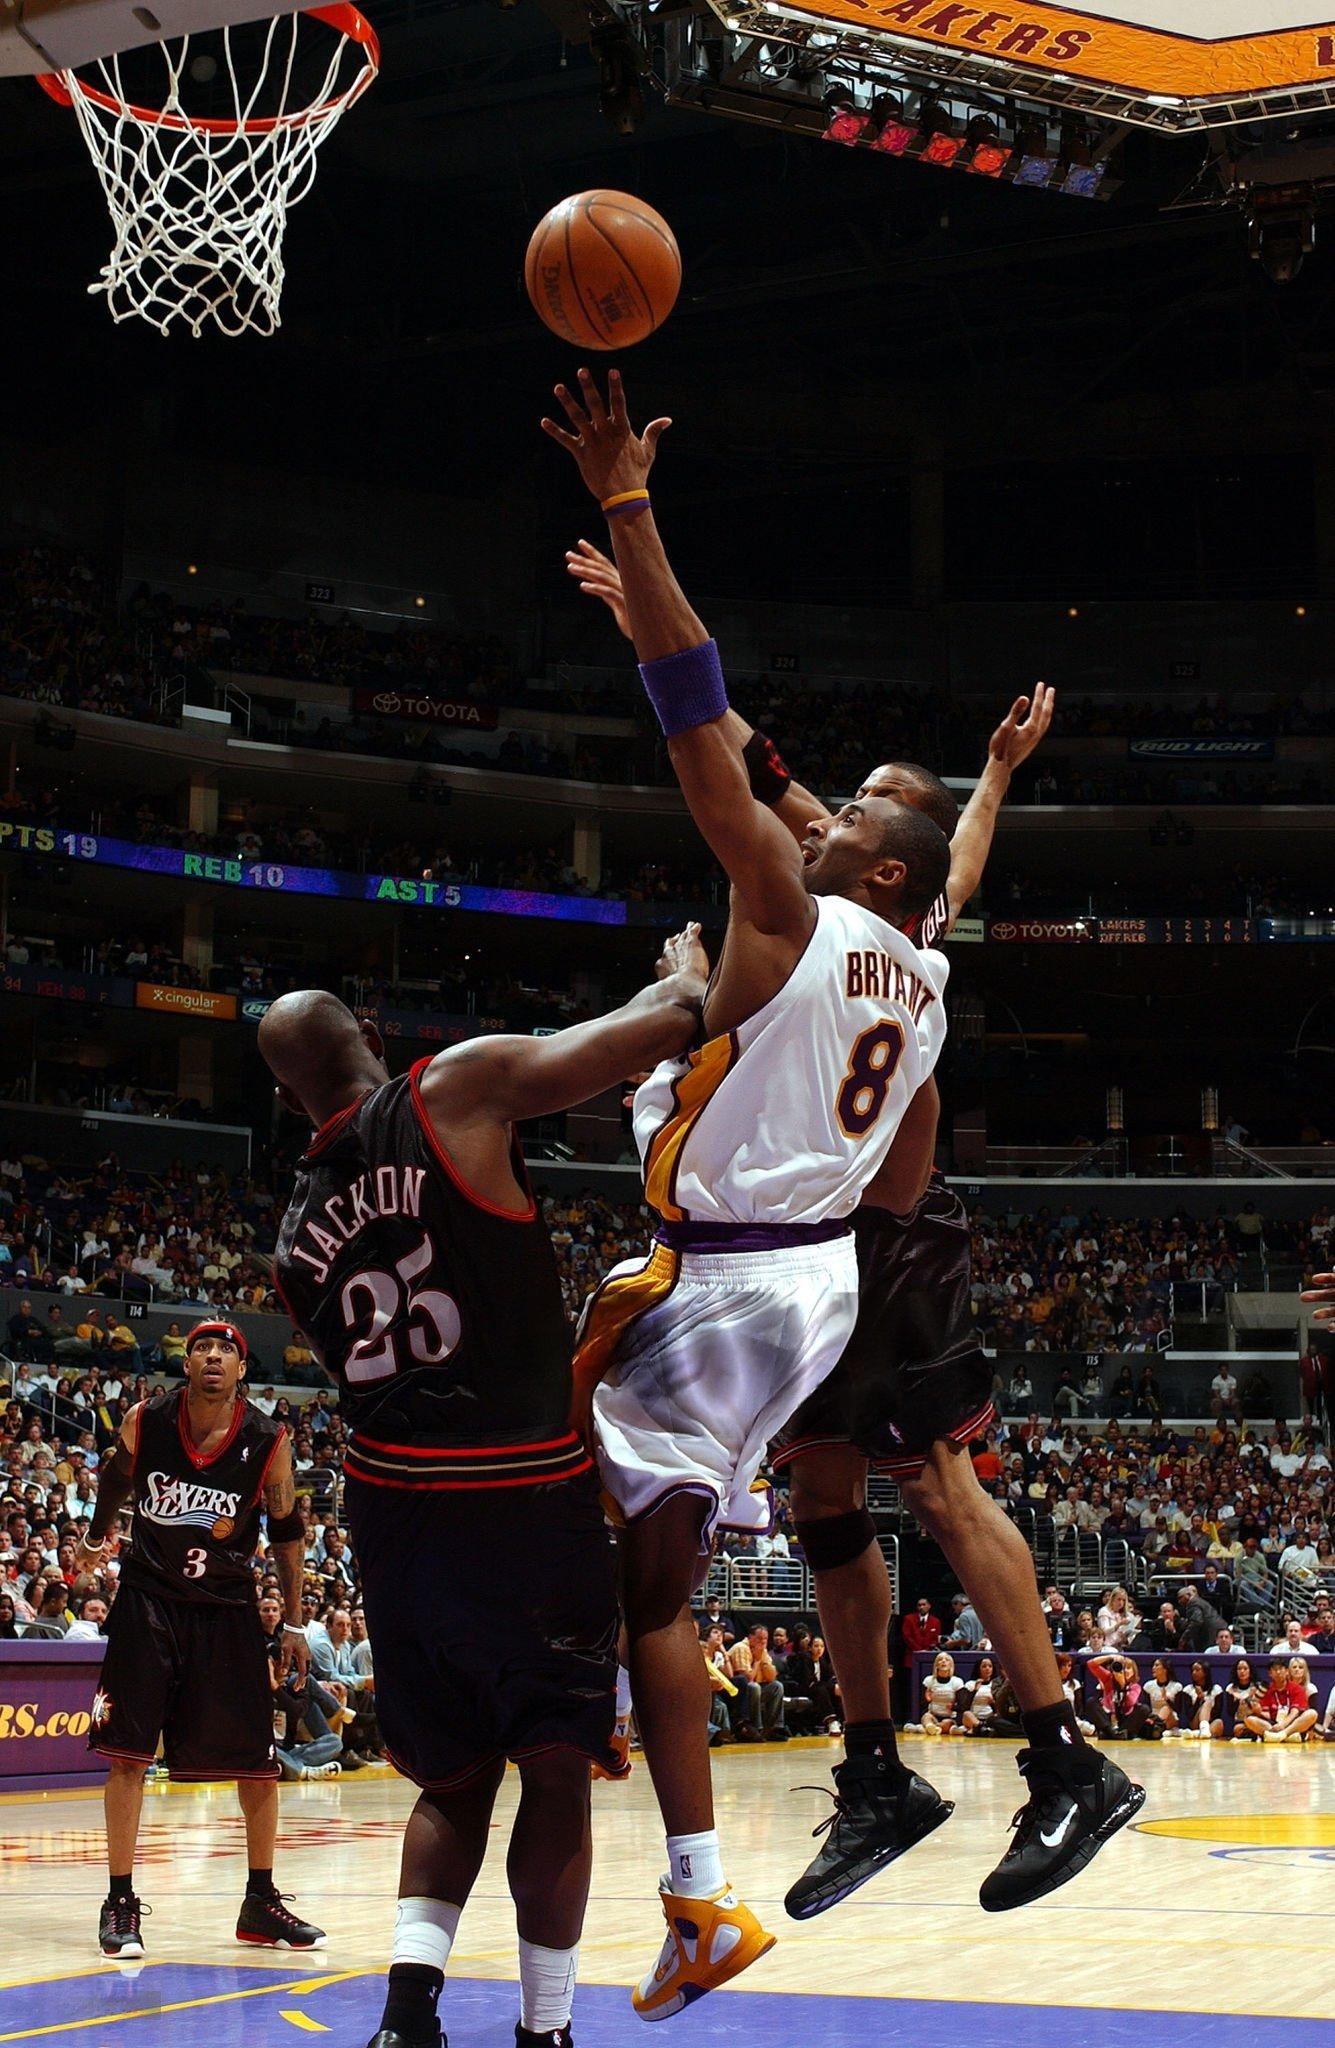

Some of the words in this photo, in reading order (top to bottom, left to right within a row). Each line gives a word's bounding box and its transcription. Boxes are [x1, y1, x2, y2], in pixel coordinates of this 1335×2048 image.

[847, 0, 1093, 60] AKERS
[309, 587, 330, 600] 323
[404, 698, 481, 722] TOYOTA
[1138, 741, 1191, 752] BUD
[1194, 741, 1267, 752] LIGHT
[0, 822, 54, 851] PTS
[63, 834, 97, 858] 19
[184, 854, 242, 882] REB
[249, 865, 284, 888] 10
[376, 878, 439, 903] AST
[444, 886, 461, 906] 5
[1019, 924, 1089, 938] TOYOTA
[1100, 920, 1146, 930] LAKERS
[165, 991, 215, 1008] cingular
[846, 951, 936, 1026] BRYANT
[834, 1018, 905, 1139] 8
[292, 1165, 426, 1283] JACKON
[129, 1305, 143, 1318] 114
[341, 1232, 462, 1384] 25
[1086, 1355, 1100, 1366] 115
[144, 1471, 242, 1519] SIXERS
[183, 1549, 207, 1579] 3
[0, 1703, 91, 1738] RS.co
